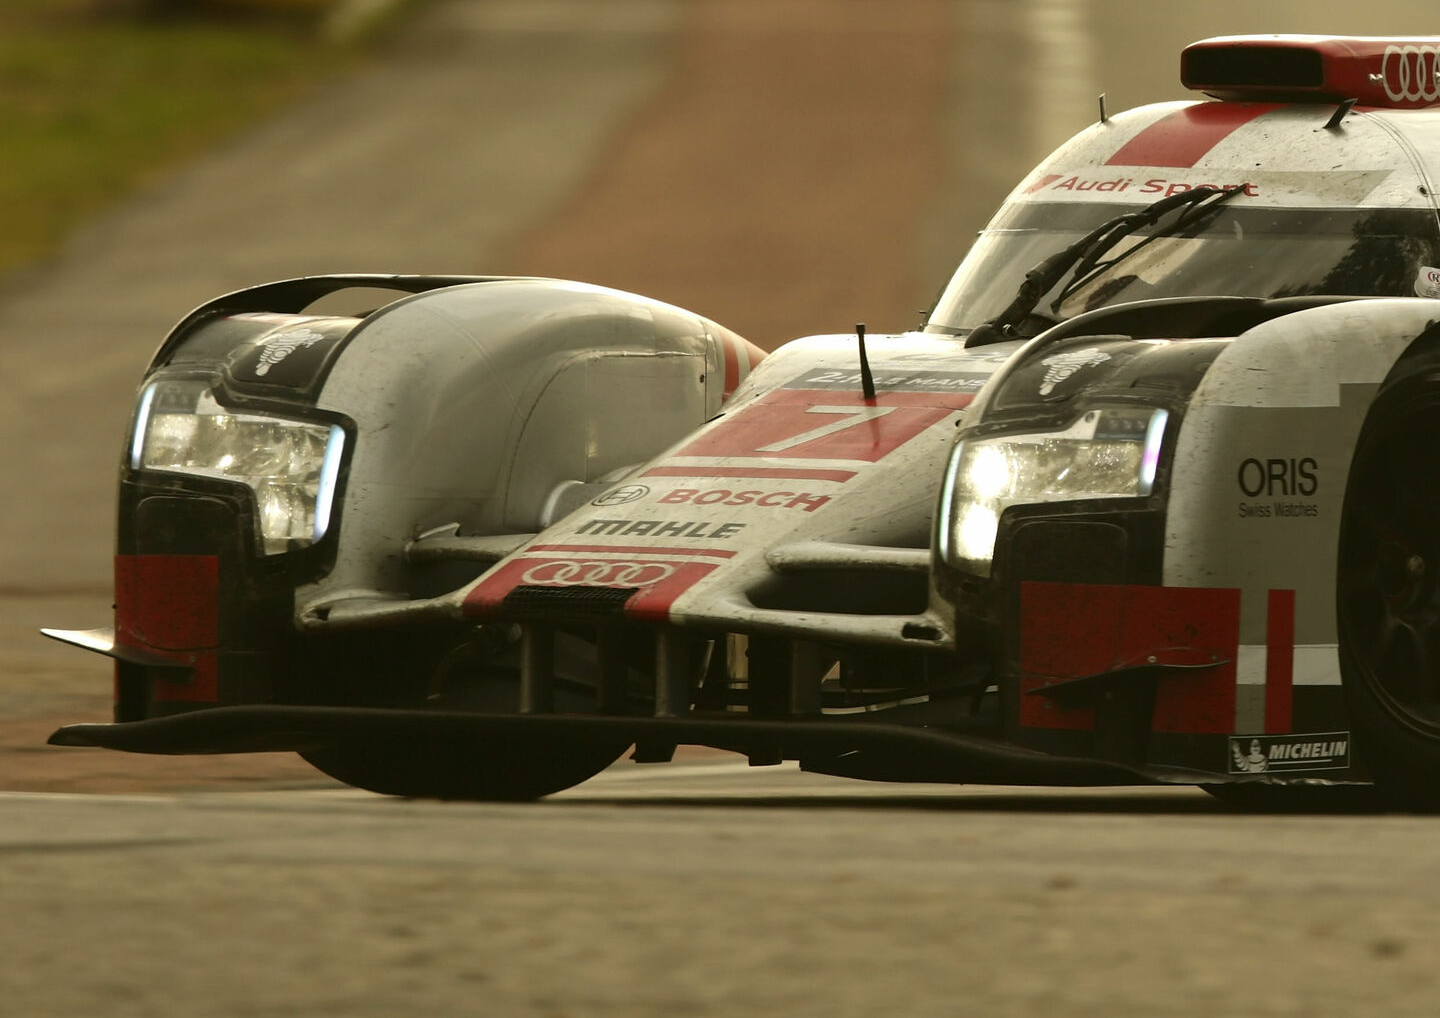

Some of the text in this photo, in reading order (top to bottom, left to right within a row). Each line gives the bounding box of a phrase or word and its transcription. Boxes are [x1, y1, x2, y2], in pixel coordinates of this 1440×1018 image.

[1051, 176, 1133, 193] Audi
[755, 405, 898, 452] 7
[1238, 457, 1319, 497] ORIS
[657, 488, 832, 513] BOSCH
[1239, 503, 1271, 517] Swiss
[575, 519, 747, 539] MAHLE
[1268, 741, 1347, 760] MICHELIN
